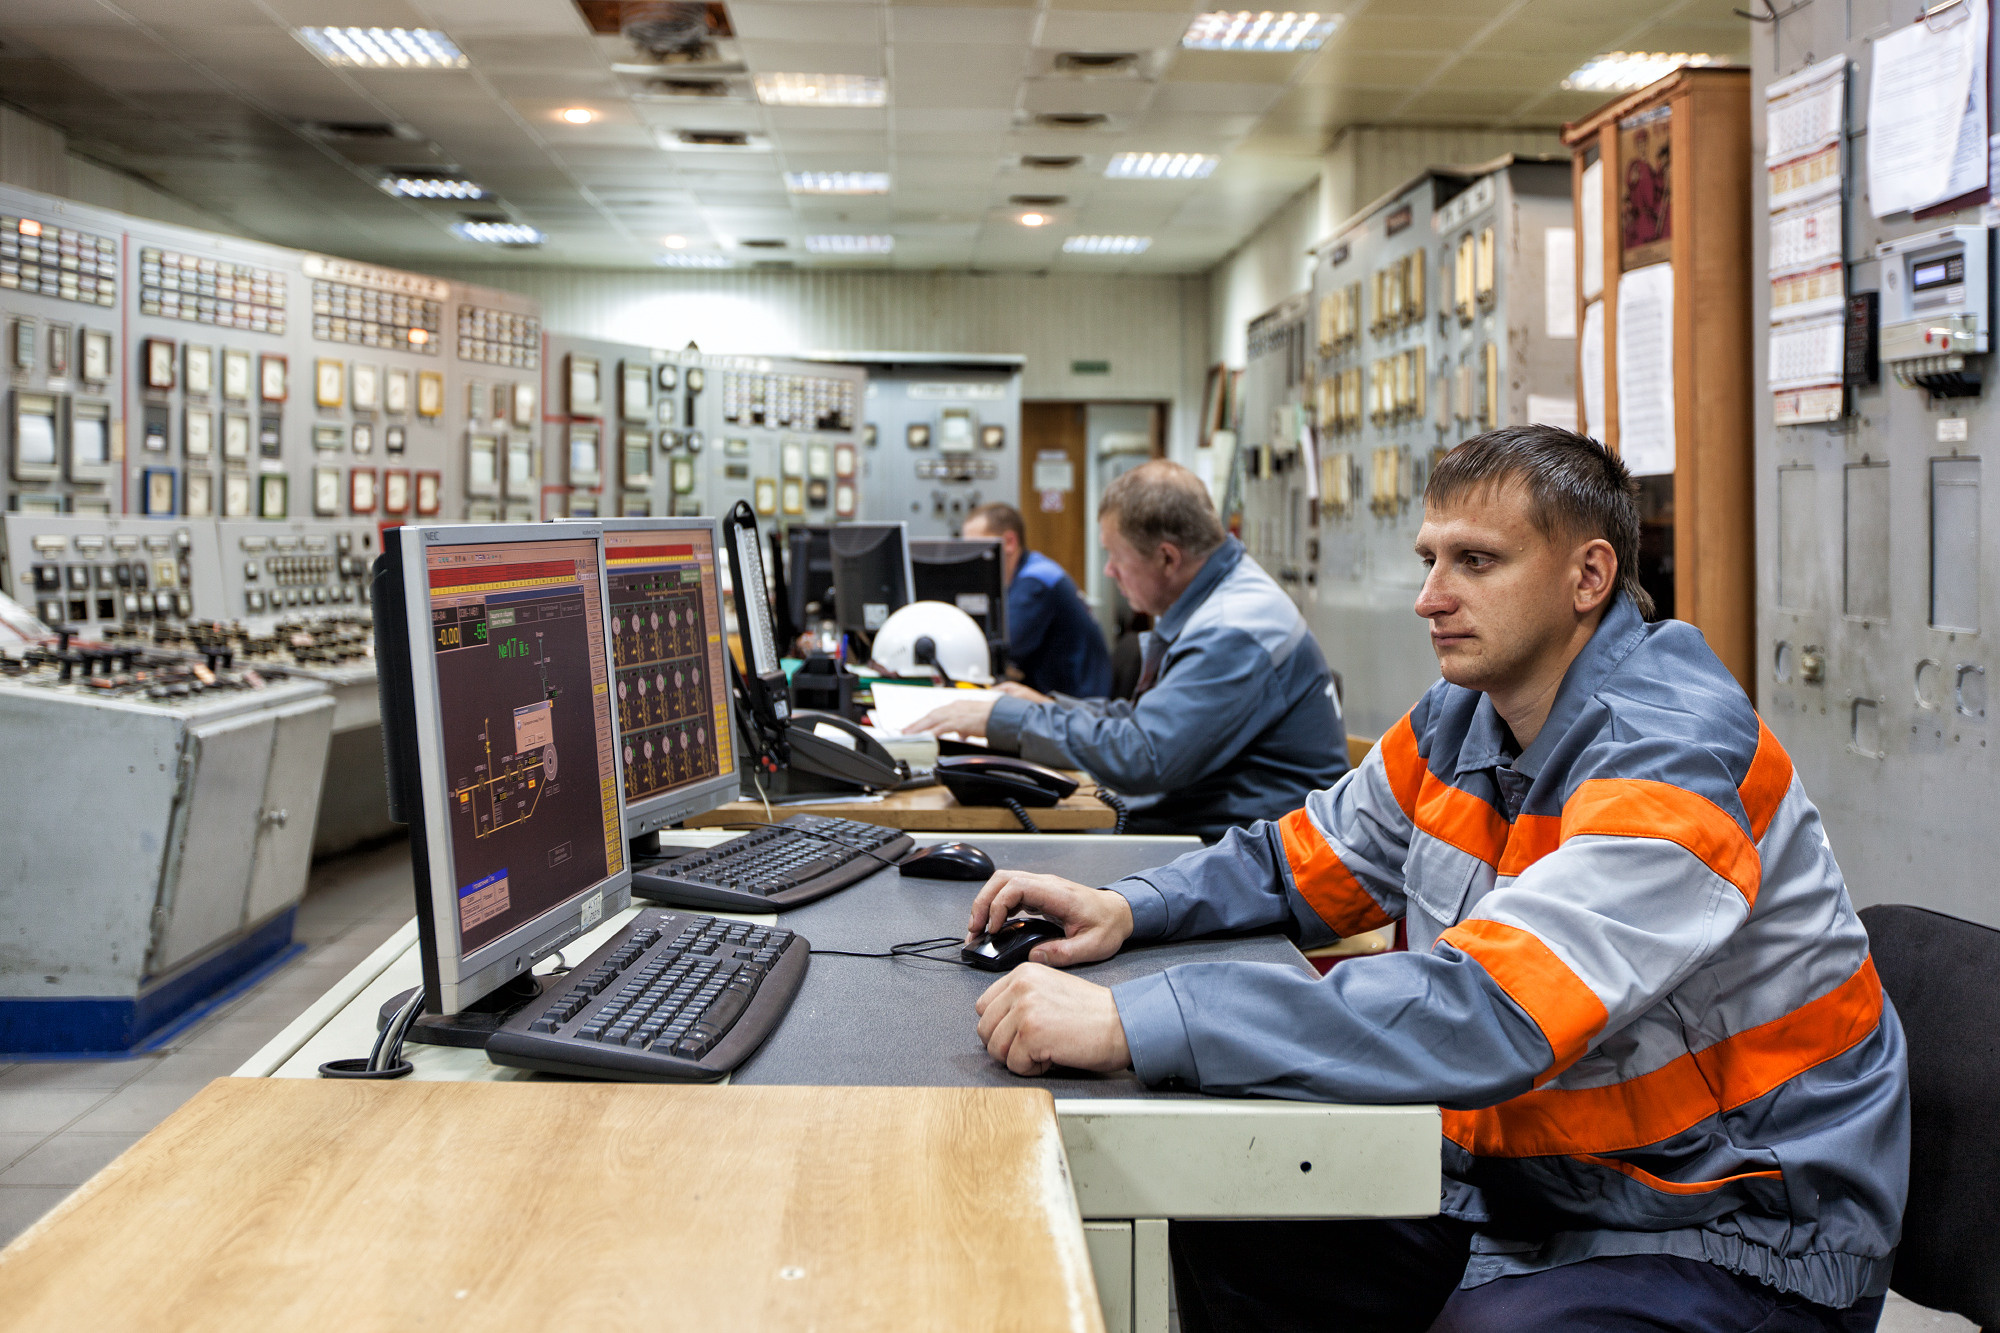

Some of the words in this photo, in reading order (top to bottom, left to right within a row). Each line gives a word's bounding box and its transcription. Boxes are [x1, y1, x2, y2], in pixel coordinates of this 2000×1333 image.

[424, 531, 440, 541] NEC
[437, 627, 460, 646] -0.00
[473, 622, 488, 640] -55
